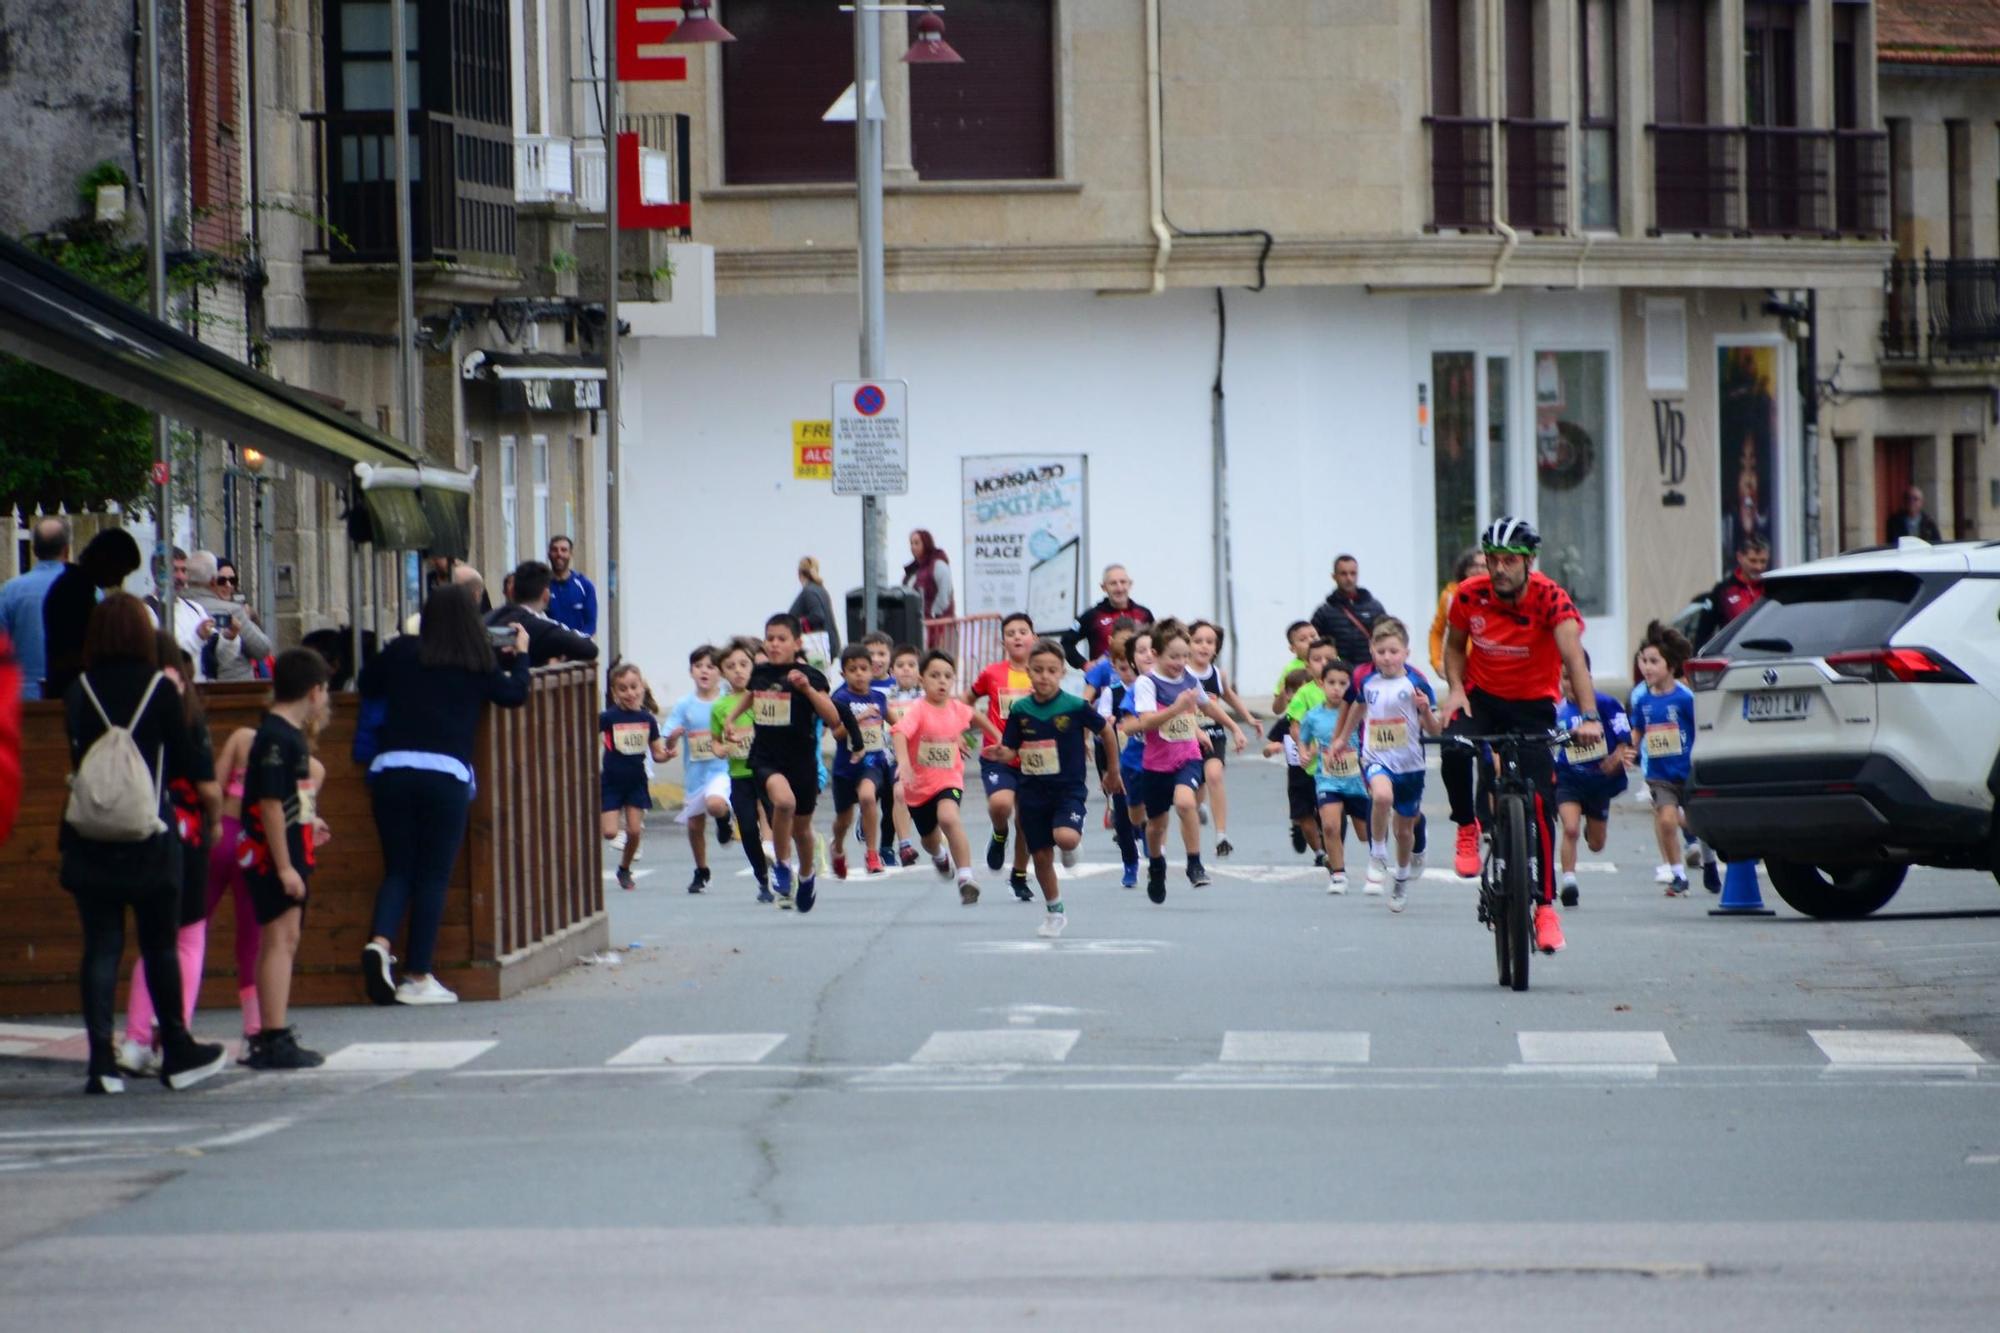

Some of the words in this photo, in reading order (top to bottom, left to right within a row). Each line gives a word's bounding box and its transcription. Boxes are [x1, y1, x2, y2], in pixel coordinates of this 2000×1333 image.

[974, 464, 1065, 495] MORRAZO
[975, 534, 1025, 543] MARKET
[975, 547, 1022, 558] PLACE
[1377, 729, 1394, 742] 414
